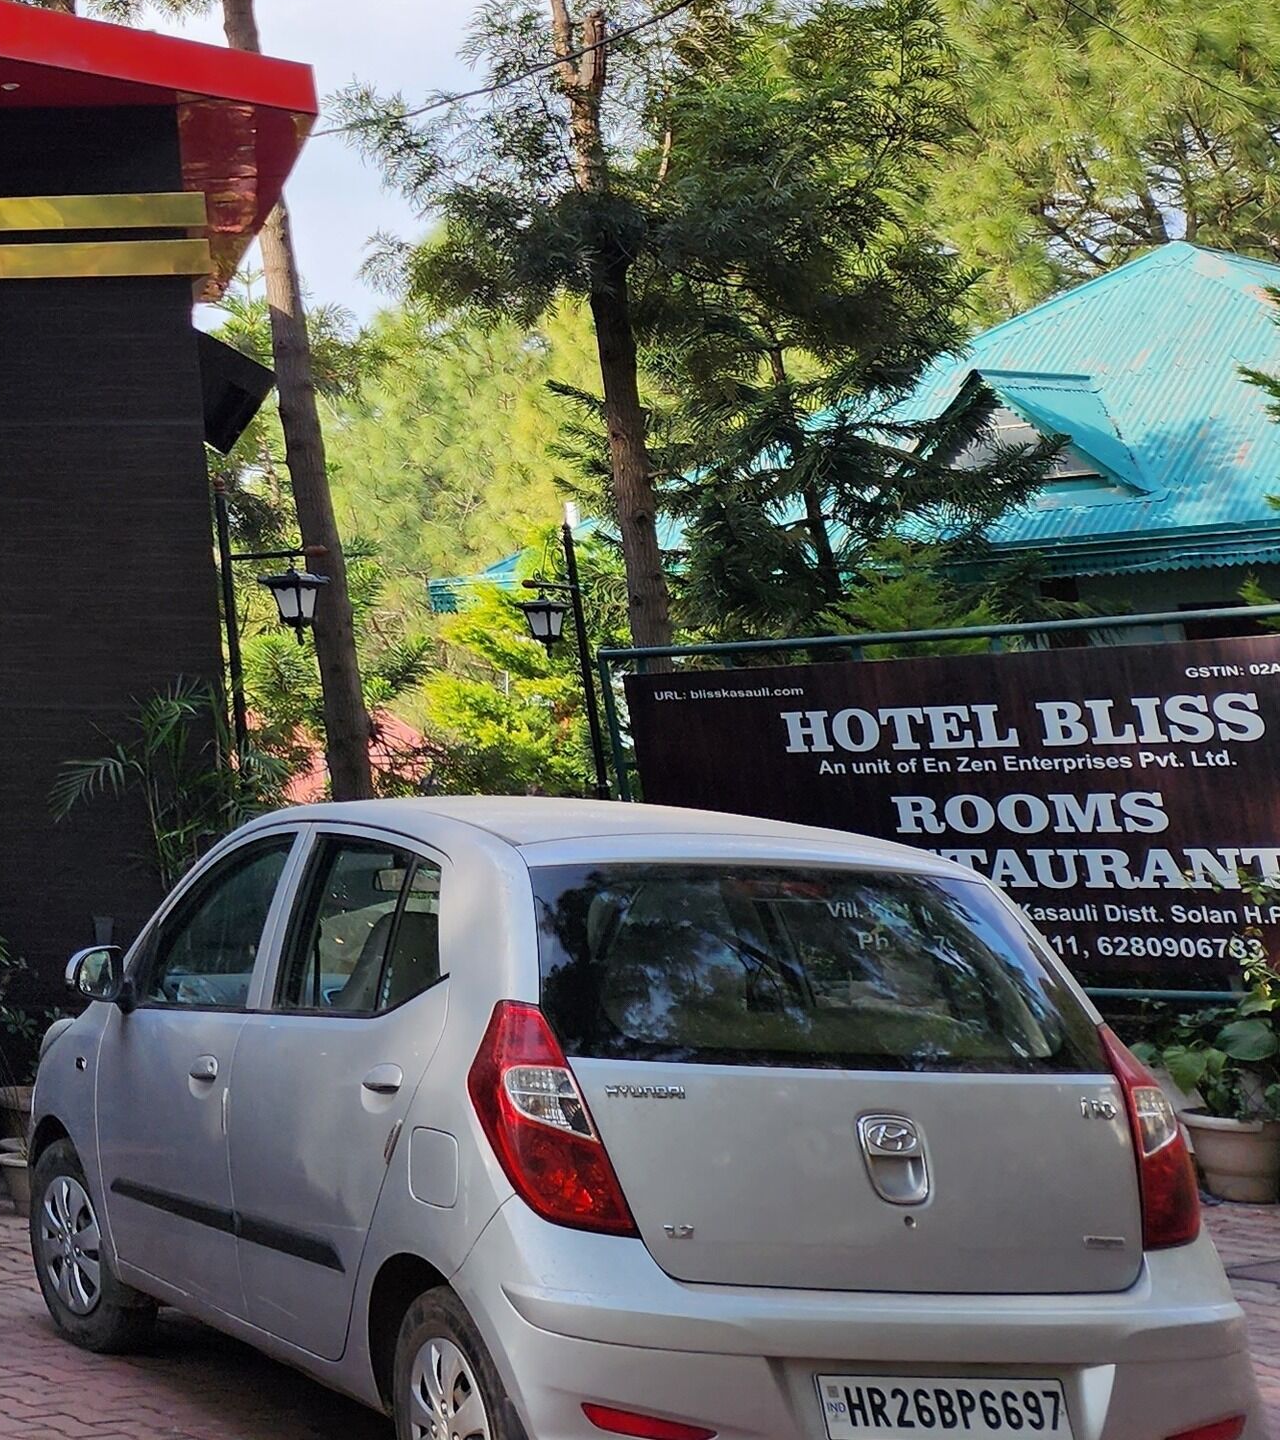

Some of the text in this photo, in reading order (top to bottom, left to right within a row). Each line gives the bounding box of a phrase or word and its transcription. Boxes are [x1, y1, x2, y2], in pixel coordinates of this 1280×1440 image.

[1185, 664, 1246, 679] GSTIN:
[654, 686, 804, 701] URL: blisskasauli.com
[780, 692, 1266, 753] HOTEL BLISS
[819, 749, 1238, 775] An unit of En Zen Enterprises Pvt. Ltd.
[891, 791, 1170, 835] ROOMS
[928, 847, 1280, 891] TAURANT
[1105, 904, 1165, 924] Distt.
[1171, 904, 1238, 925] Solan
[605, 1085, 686, 1099] HYUNDAI
[844, 1385, 1061, 1431] HR26BP6697
